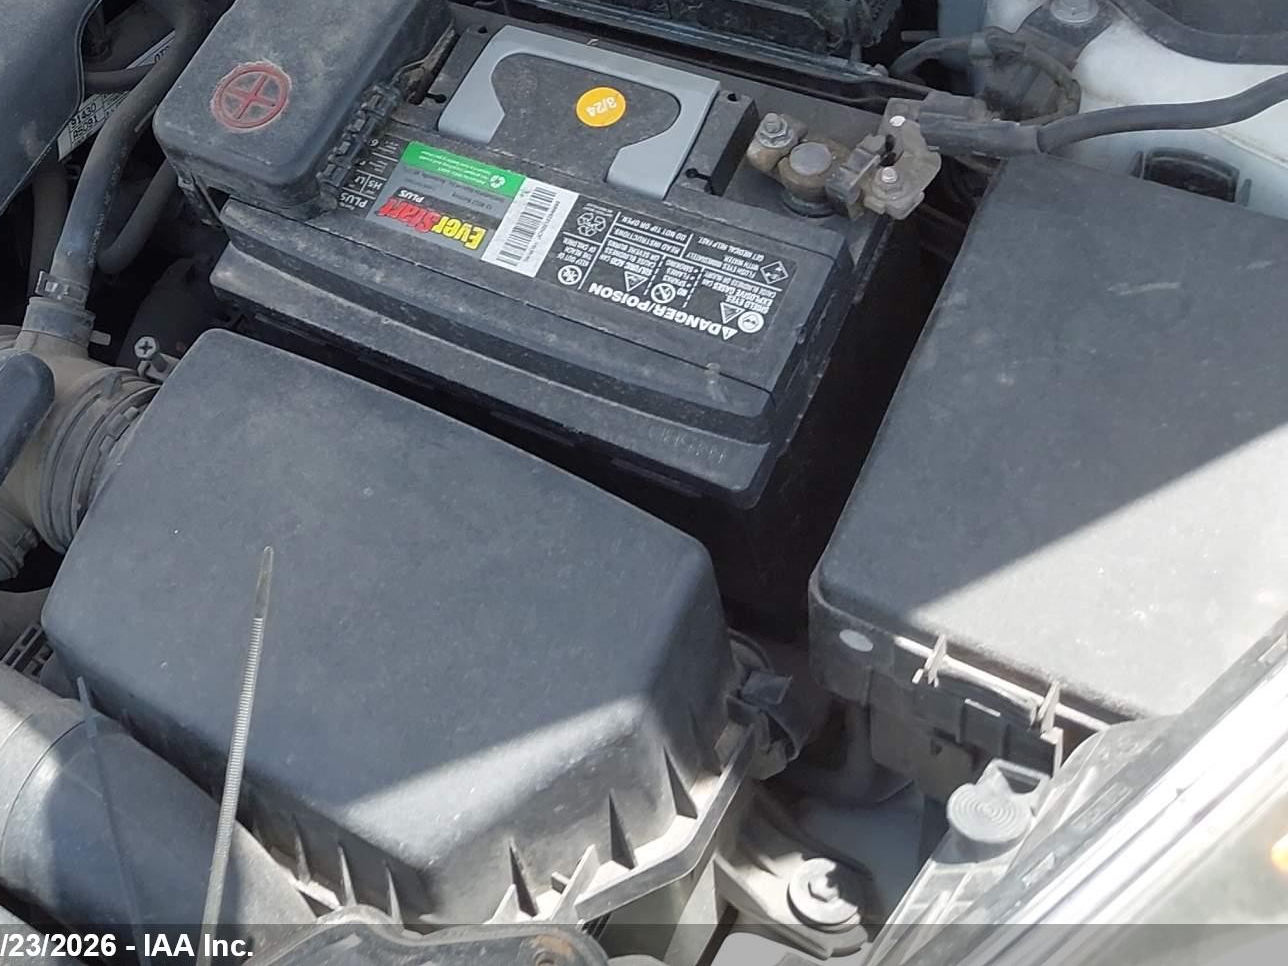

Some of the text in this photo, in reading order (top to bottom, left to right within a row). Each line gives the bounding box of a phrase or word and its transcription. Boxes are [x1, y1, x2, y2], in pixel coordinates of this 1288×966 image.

[585, 96, 617, 118] 3/24
[366, 178, 383, 190] H5
[339, 191, 369, 209] PLUS
[397, 188, 425, 203] PLUS
[376, 198, 487, 250] EverStart
[659, 242, 681, 254] READ
[733, 287, 774, 307] EXPLOSIVE
[586, 281, 723, 336] DANGER/POISON
